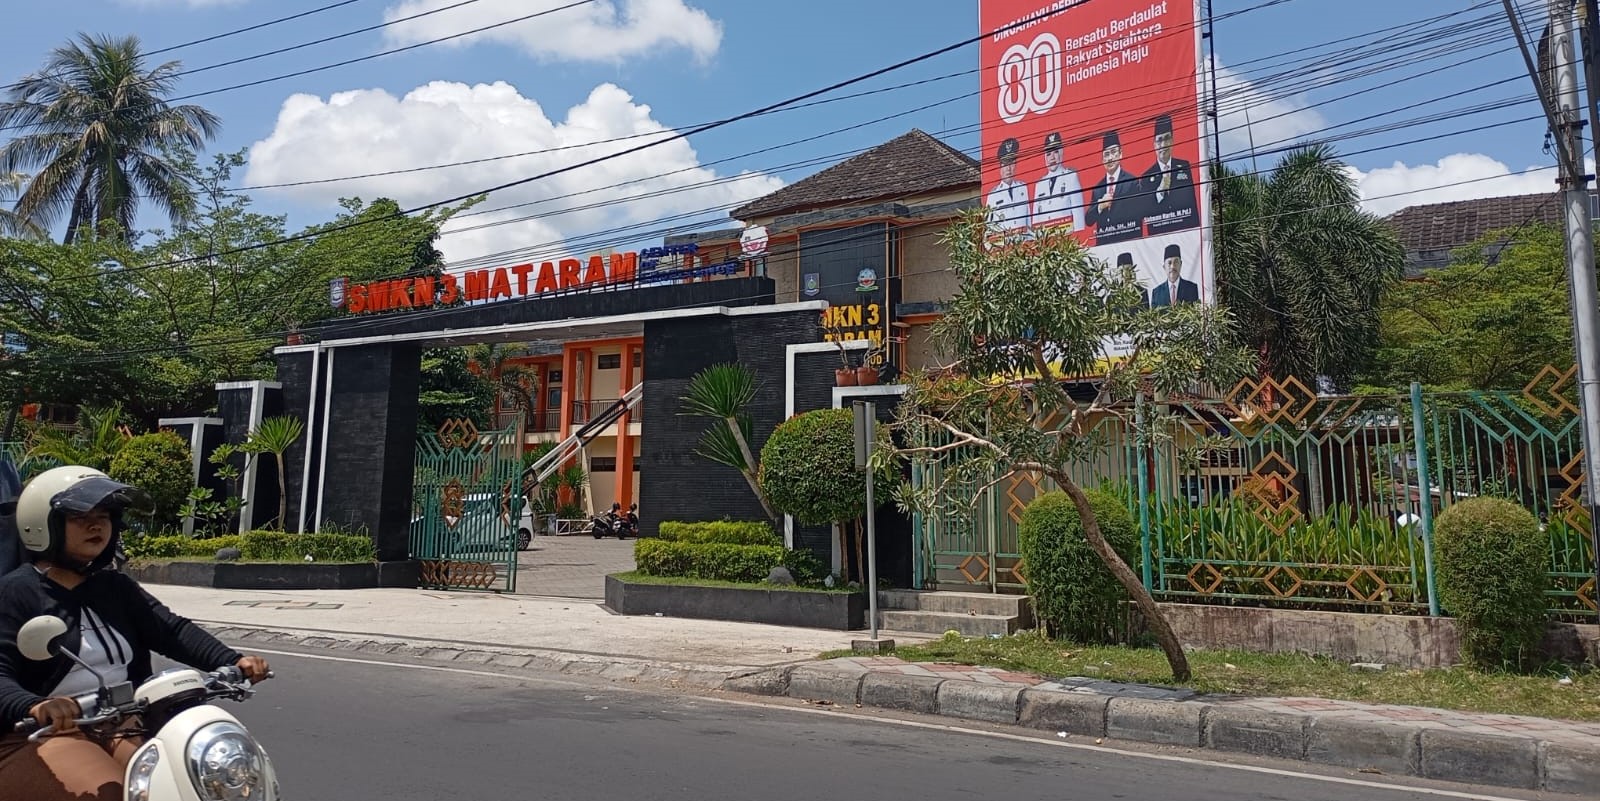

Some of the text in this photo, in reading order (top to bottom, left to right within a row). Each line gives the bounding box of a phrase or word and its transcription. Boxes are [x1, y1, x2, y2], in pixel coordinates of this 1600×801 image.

[1065, 0, 1168, 51] Bersatu Berdaulat
[1065, 23, 1162, 69] Rakyat Sejahtera
[997, 32, 1062, 124] 80
[1066, 45, 1149, 85] Indonesia Maju
[348, 252, 636, 314] SMKN 3 MATARAM
[867, 304, 880, 325] 3
